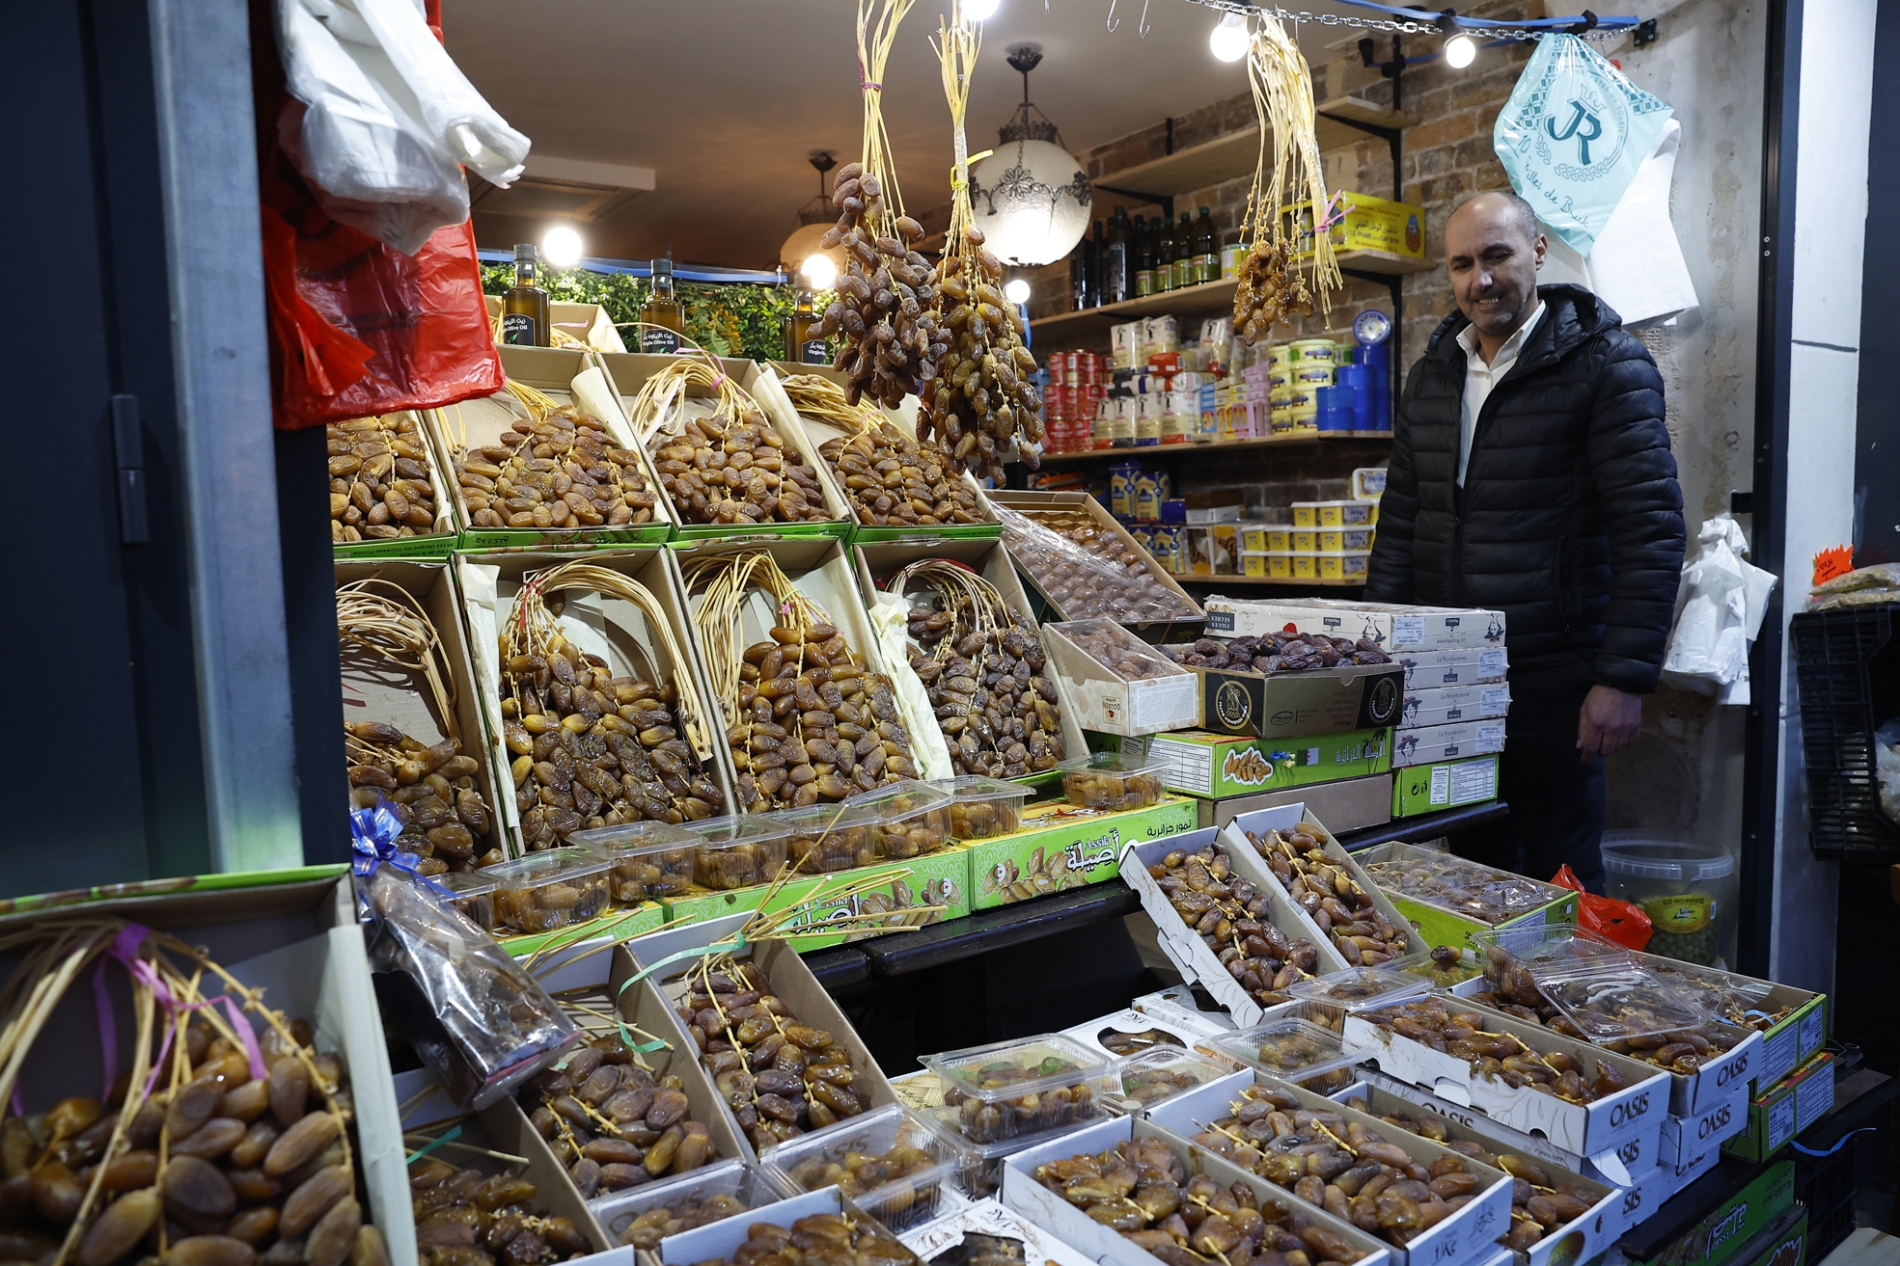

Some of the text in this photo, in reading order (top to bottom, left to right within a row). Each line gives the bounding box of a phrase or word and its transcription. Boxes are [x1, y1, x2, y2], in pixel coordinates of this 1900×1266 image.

[1517, 135, 1532, 154] 10
[1544, 188, 1558, 204] de
[1560, 196, 1590, 229] Brick
[1102, 700, 1121, 710] GOLDEN
[1086, 835, 1112, 850] Assila
[1147, 819, 1192, 837] تمور جزائرية
[1716, 1051, 1749, 1088] OASIS
[1610, 1091, 1650, 1128] OASIS
[1698, 1103, 1731, 1140] OASIS
[1616, 1138, 1641, 1167] ASIS
[1622, 1186, 1642, 1216] SIS
